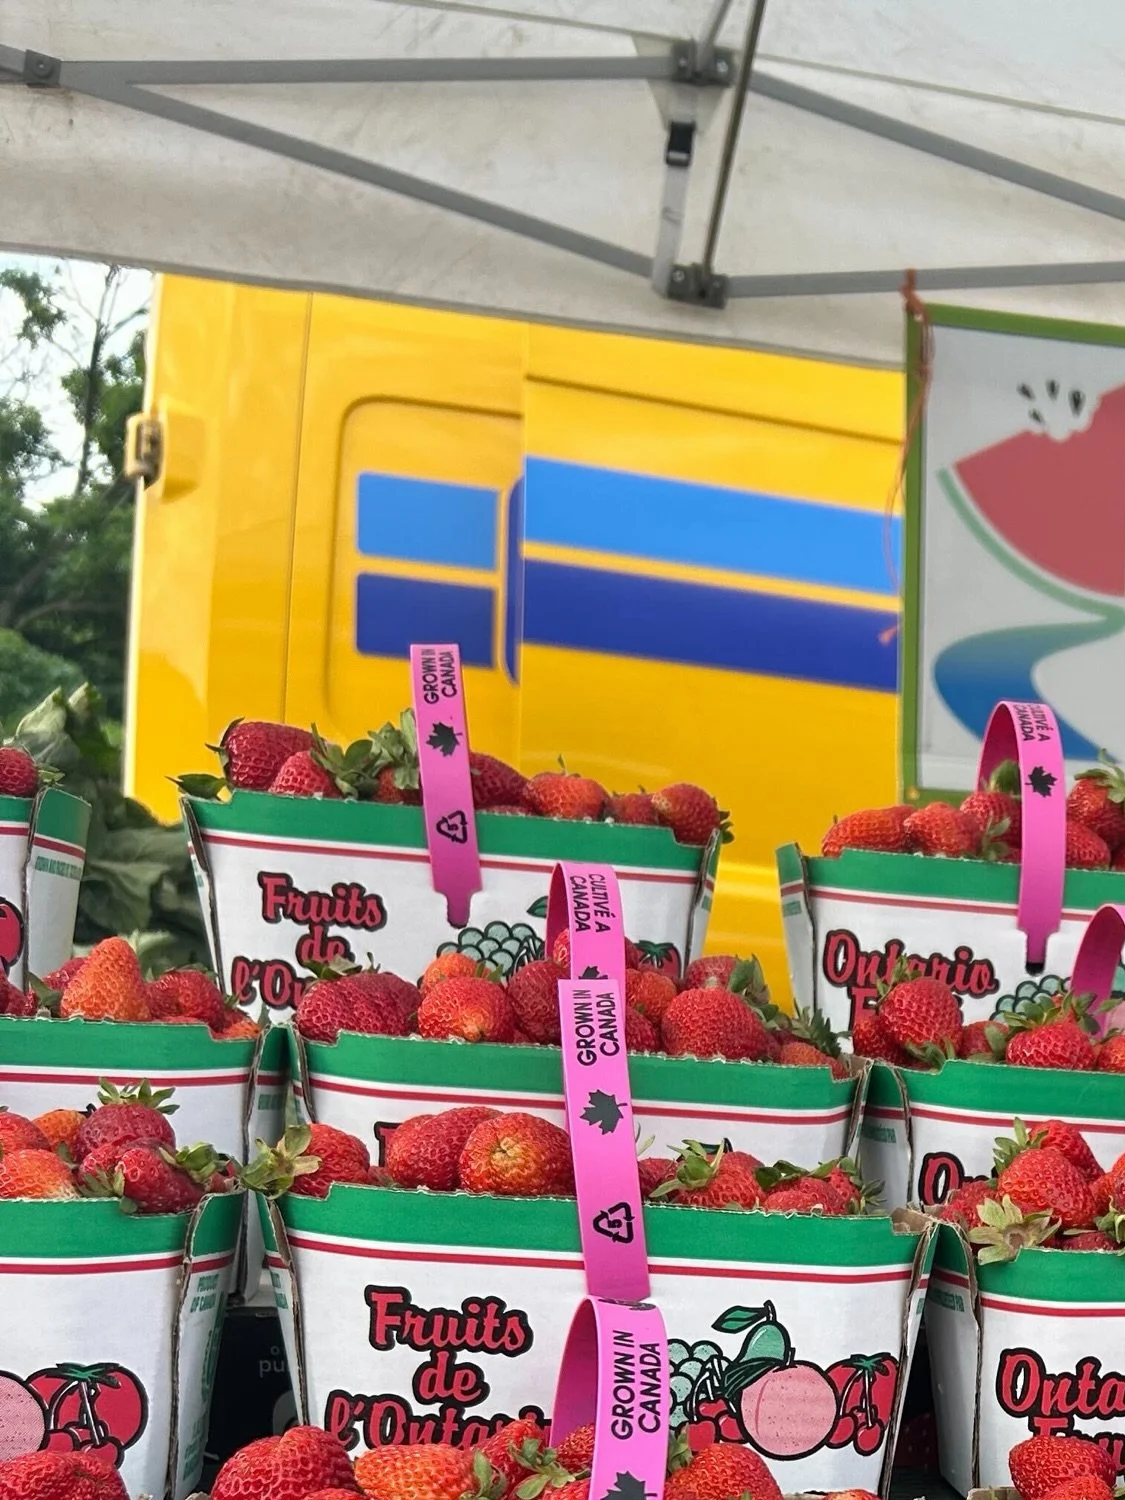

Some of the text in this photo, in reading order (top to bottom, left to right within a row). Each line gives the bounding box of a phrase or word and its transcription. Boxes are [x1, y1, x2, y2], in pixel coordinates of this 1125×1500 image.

[422, 658, 440, 704] GROWN
[440, 652, 457, 698] CANADA
[257, 871, 388, 932] Fruits
[570, 876, 591, 932] CANADA
[588, 873, 616, 920] CULTIVÉ
[573, 989, 598, 1066] GROWN IN
[596, 992, 620, 1056] CANADA
[364, 1284, 534, 1357] Fruits
[412, 1349, 490, 1407] de
[611, 1330, 636, 1440] GROWN IN
[638, 1343, 662, 1433] CANADA
[324, 1389, 552, 1451] l'Onta
